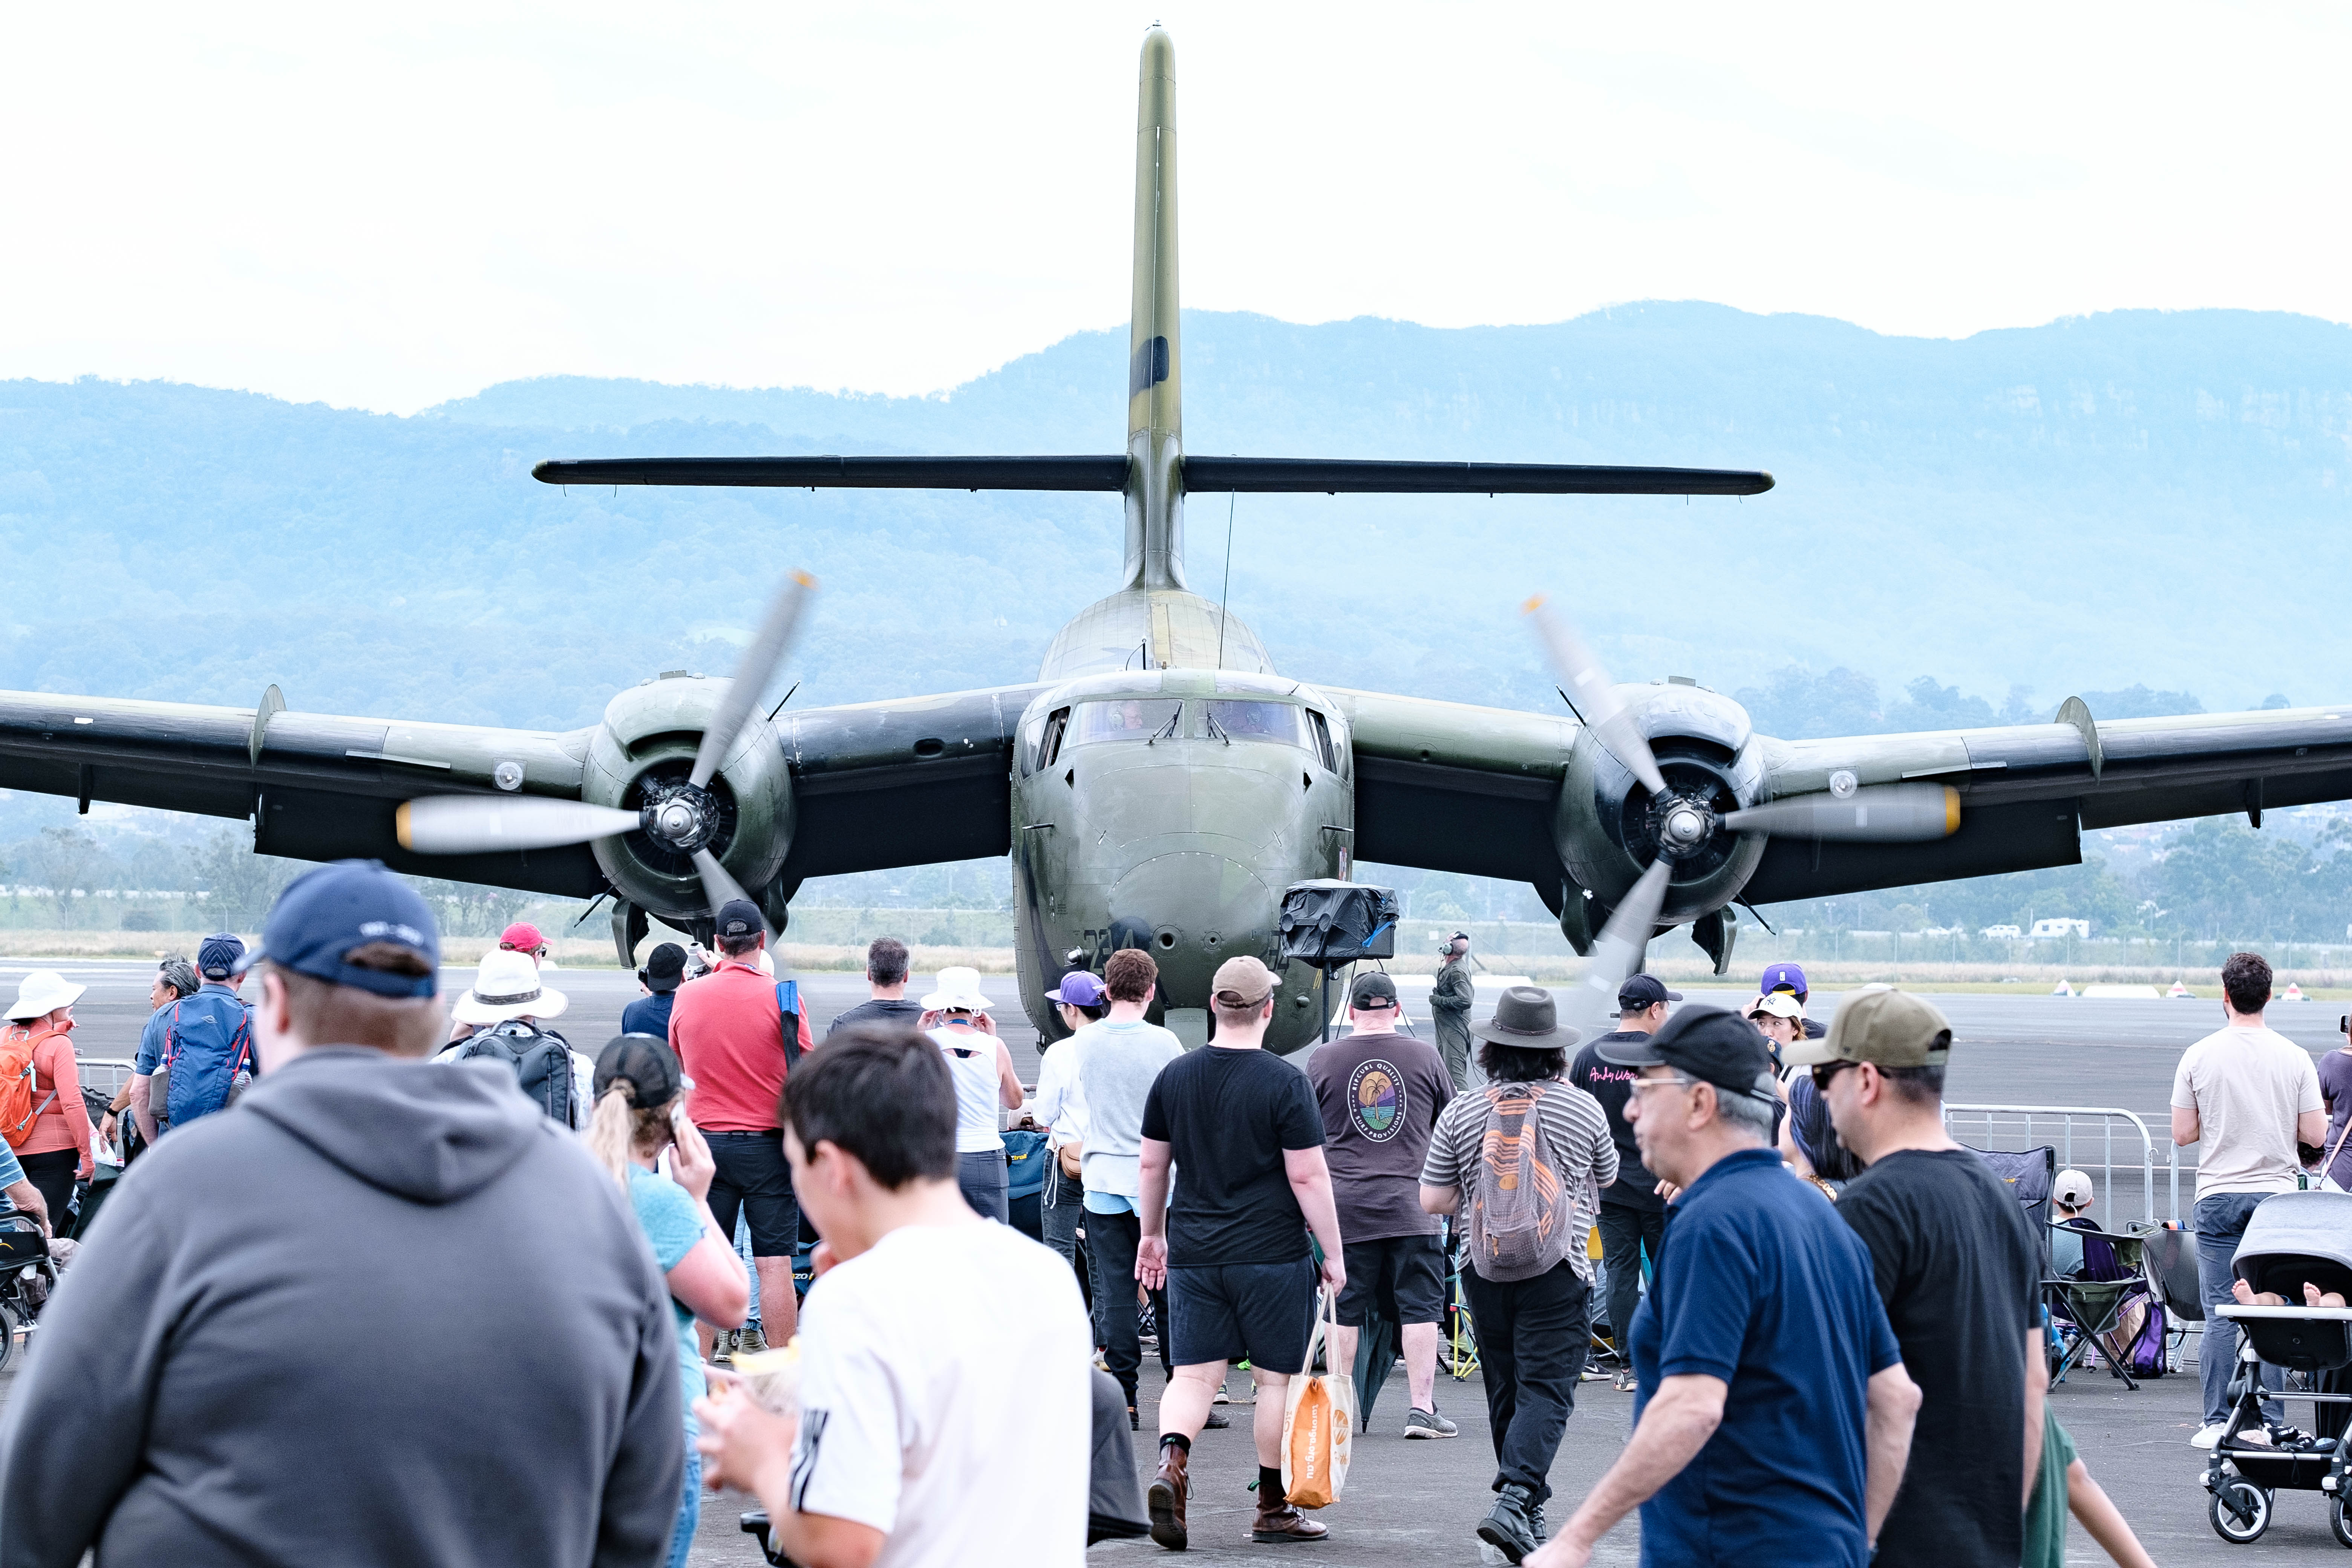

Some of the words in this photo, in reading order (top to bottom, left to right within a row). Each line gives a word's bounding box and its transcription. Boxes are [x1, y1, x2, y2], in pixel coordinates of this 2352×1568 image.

[1352, 1064, 1373, 1090] RIPCURL
[1377, 1063, 1400, 1086] QUALITY
[1589, 1067, 1614, 1083] Andy
[1355, 1116, 1368, 1131] SURF
[1369, 1112, 1402, 1138] PROVISIONS
[1305, 1404, 1319, 1479] taronga.org.au
